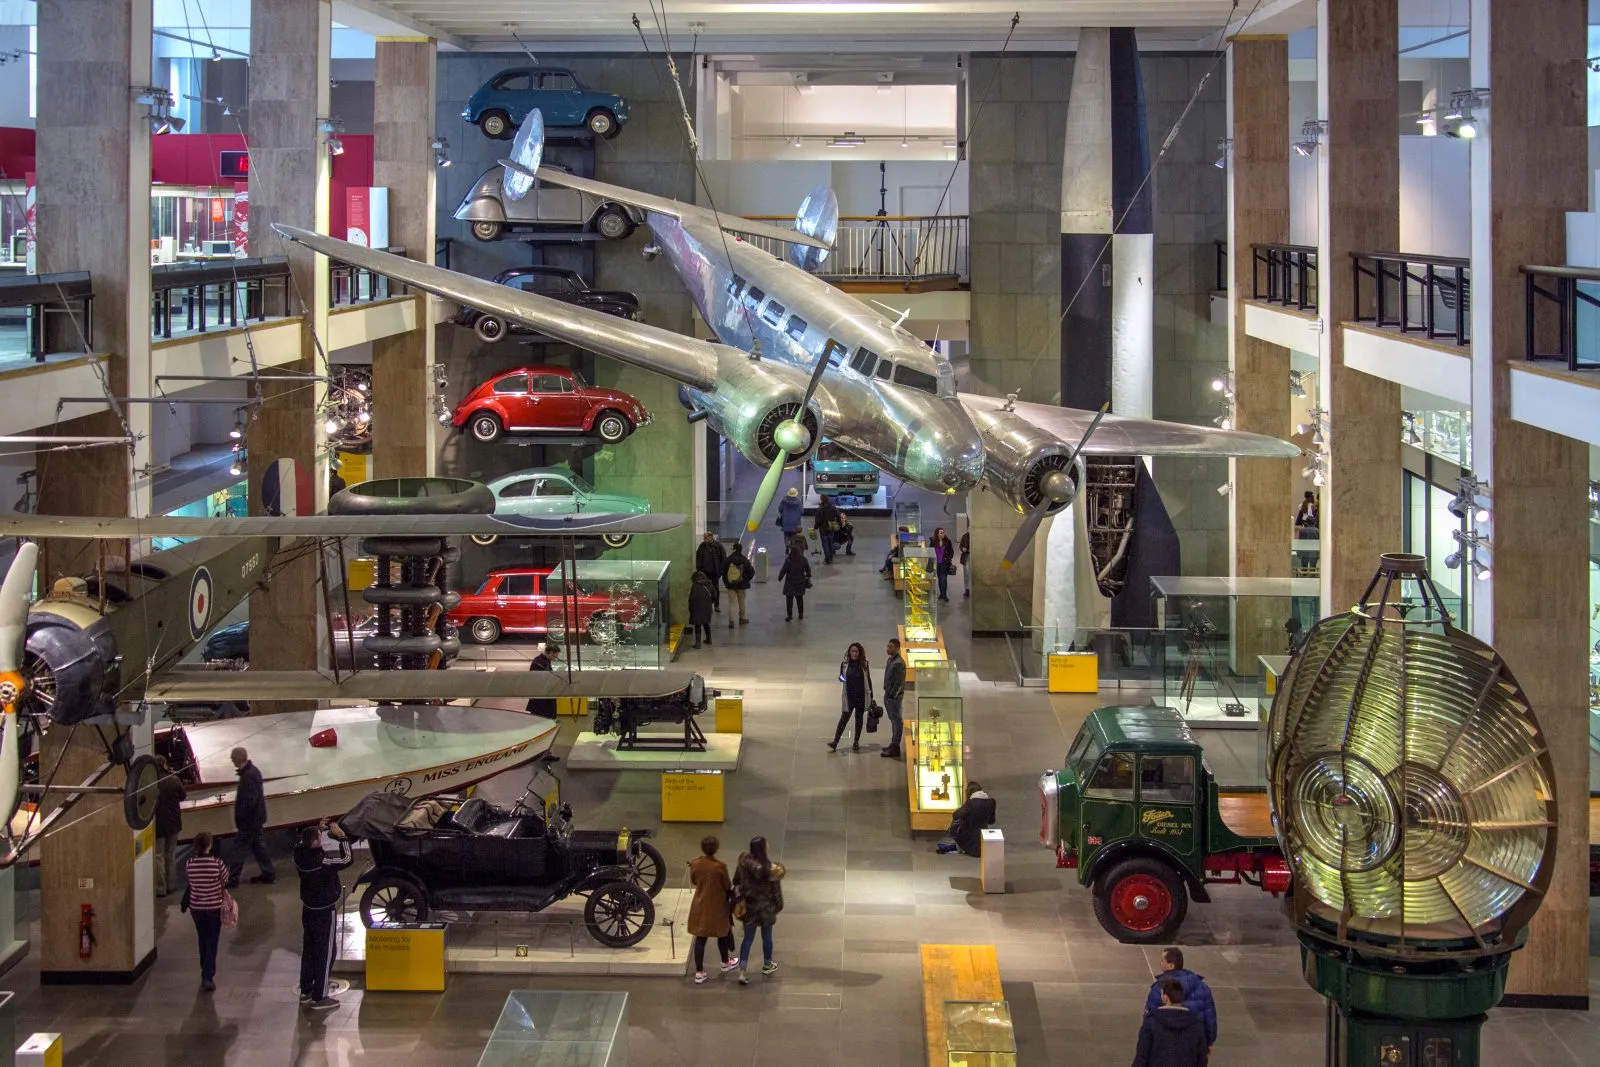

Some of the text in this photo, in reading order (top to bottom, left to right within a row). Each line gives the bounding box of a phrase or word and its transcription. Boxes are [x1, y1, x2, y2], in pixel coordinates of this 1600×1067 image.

[422, 744, 529, 783] MISS ENGLAND
[394, 780, 403, 788] R
[1142, 809, 1175, 825] Foden
[368, 935, 401, 943] Motoring
